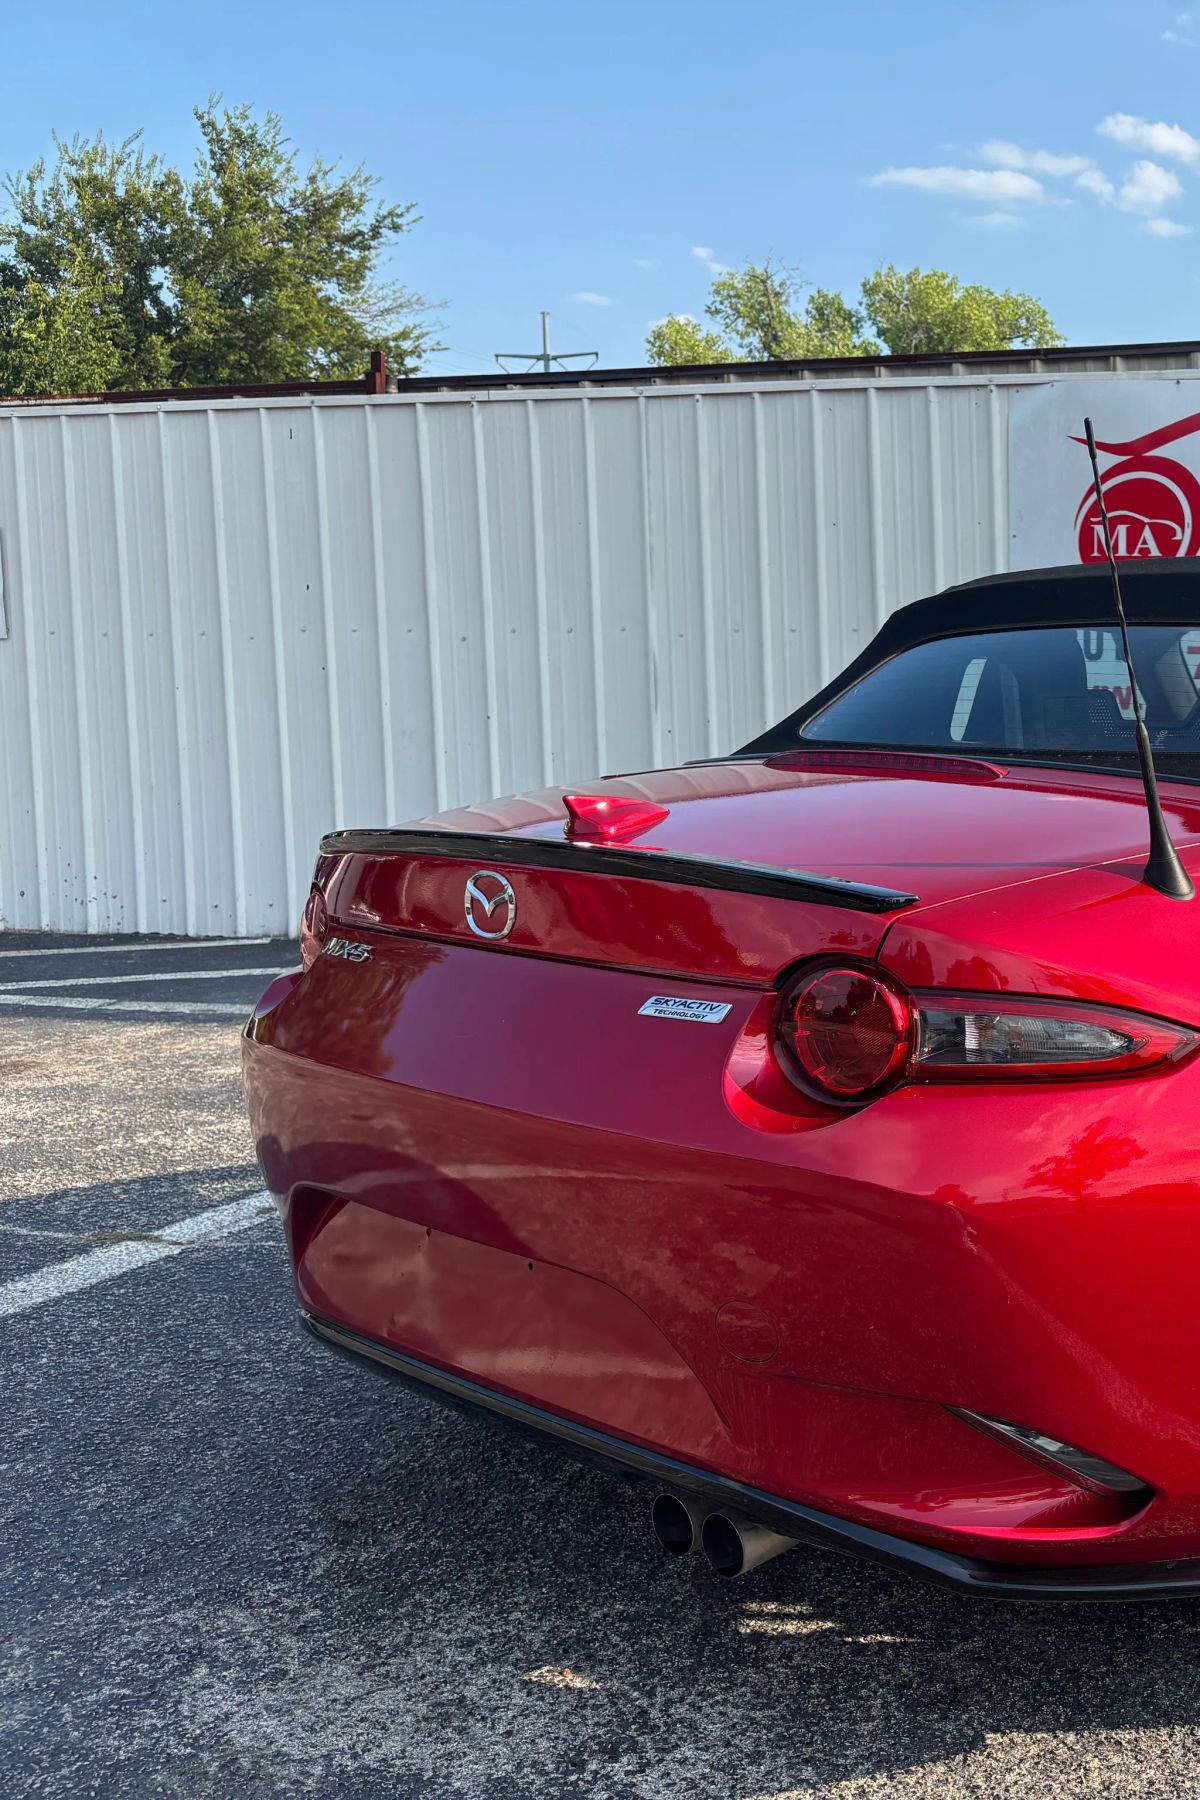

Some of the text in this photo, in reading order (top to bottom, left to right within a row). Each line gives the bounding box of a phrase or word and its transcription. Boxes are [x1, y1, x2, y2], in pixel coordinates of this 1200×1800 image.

[1090, 524, 1163, 557] MA
[651, 997, 721, 1011] SKYACTIV
[653, 1008, 709, 1020] TECHNOLOGY
